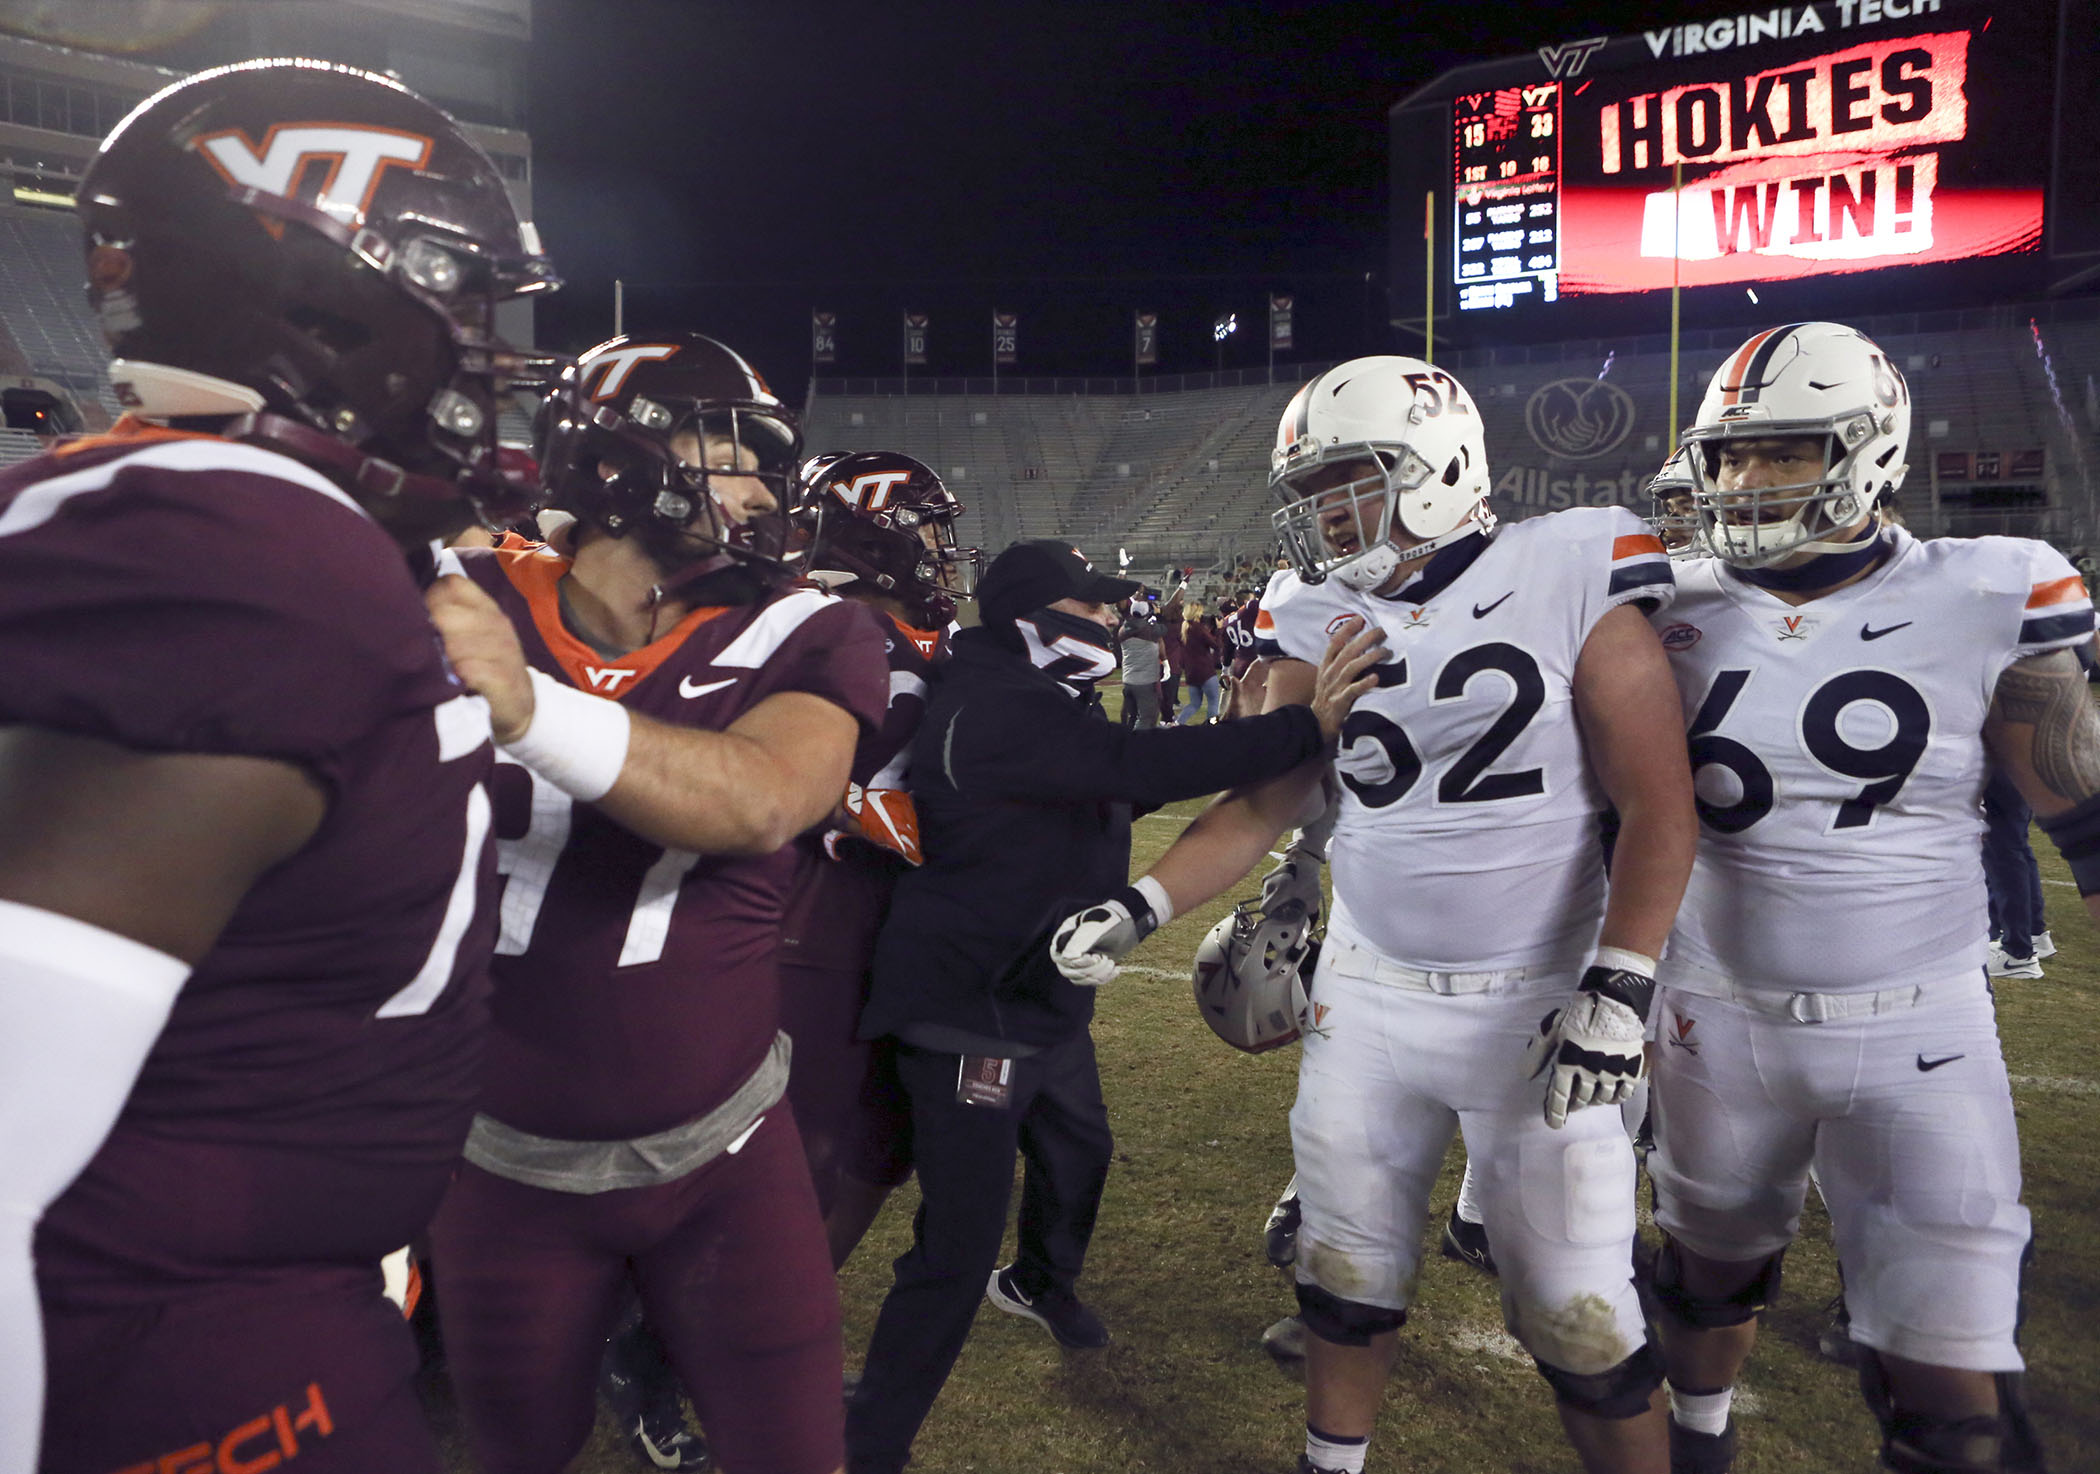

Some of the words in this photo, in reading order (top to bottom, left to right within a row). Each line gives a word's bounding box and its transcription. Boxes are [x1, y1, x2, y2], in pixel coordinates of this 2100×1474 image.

[1643, 4, 1825, 59] VIRGINIA
[1538, 37, 1607, 77] VT
[1530, 112, 1554, 138] 33
[1618, 47, 1934, 168] HOKIES
[1464, 123, 1485, 148] 15
[195, 121, 433, 239] VT
[1711, 165, 1915, 253] WIN!
[815, 336, 834, 352] 84
[910, 337, 924, 353] 10
[997, 336, 1015, 352] 25
[1142, 336, 1151, 353] 7
[1401, 371, 1469, 419] 52
[1720, 405, 1752, 419] ACC
[829, 470, 912, 511] VT
[1226, 619, 1254, 650] 96
[585, 666, 636, 691] VT
[1337, 642, 1548, 809] 52
[1686, 667, 1934, 836] 69
